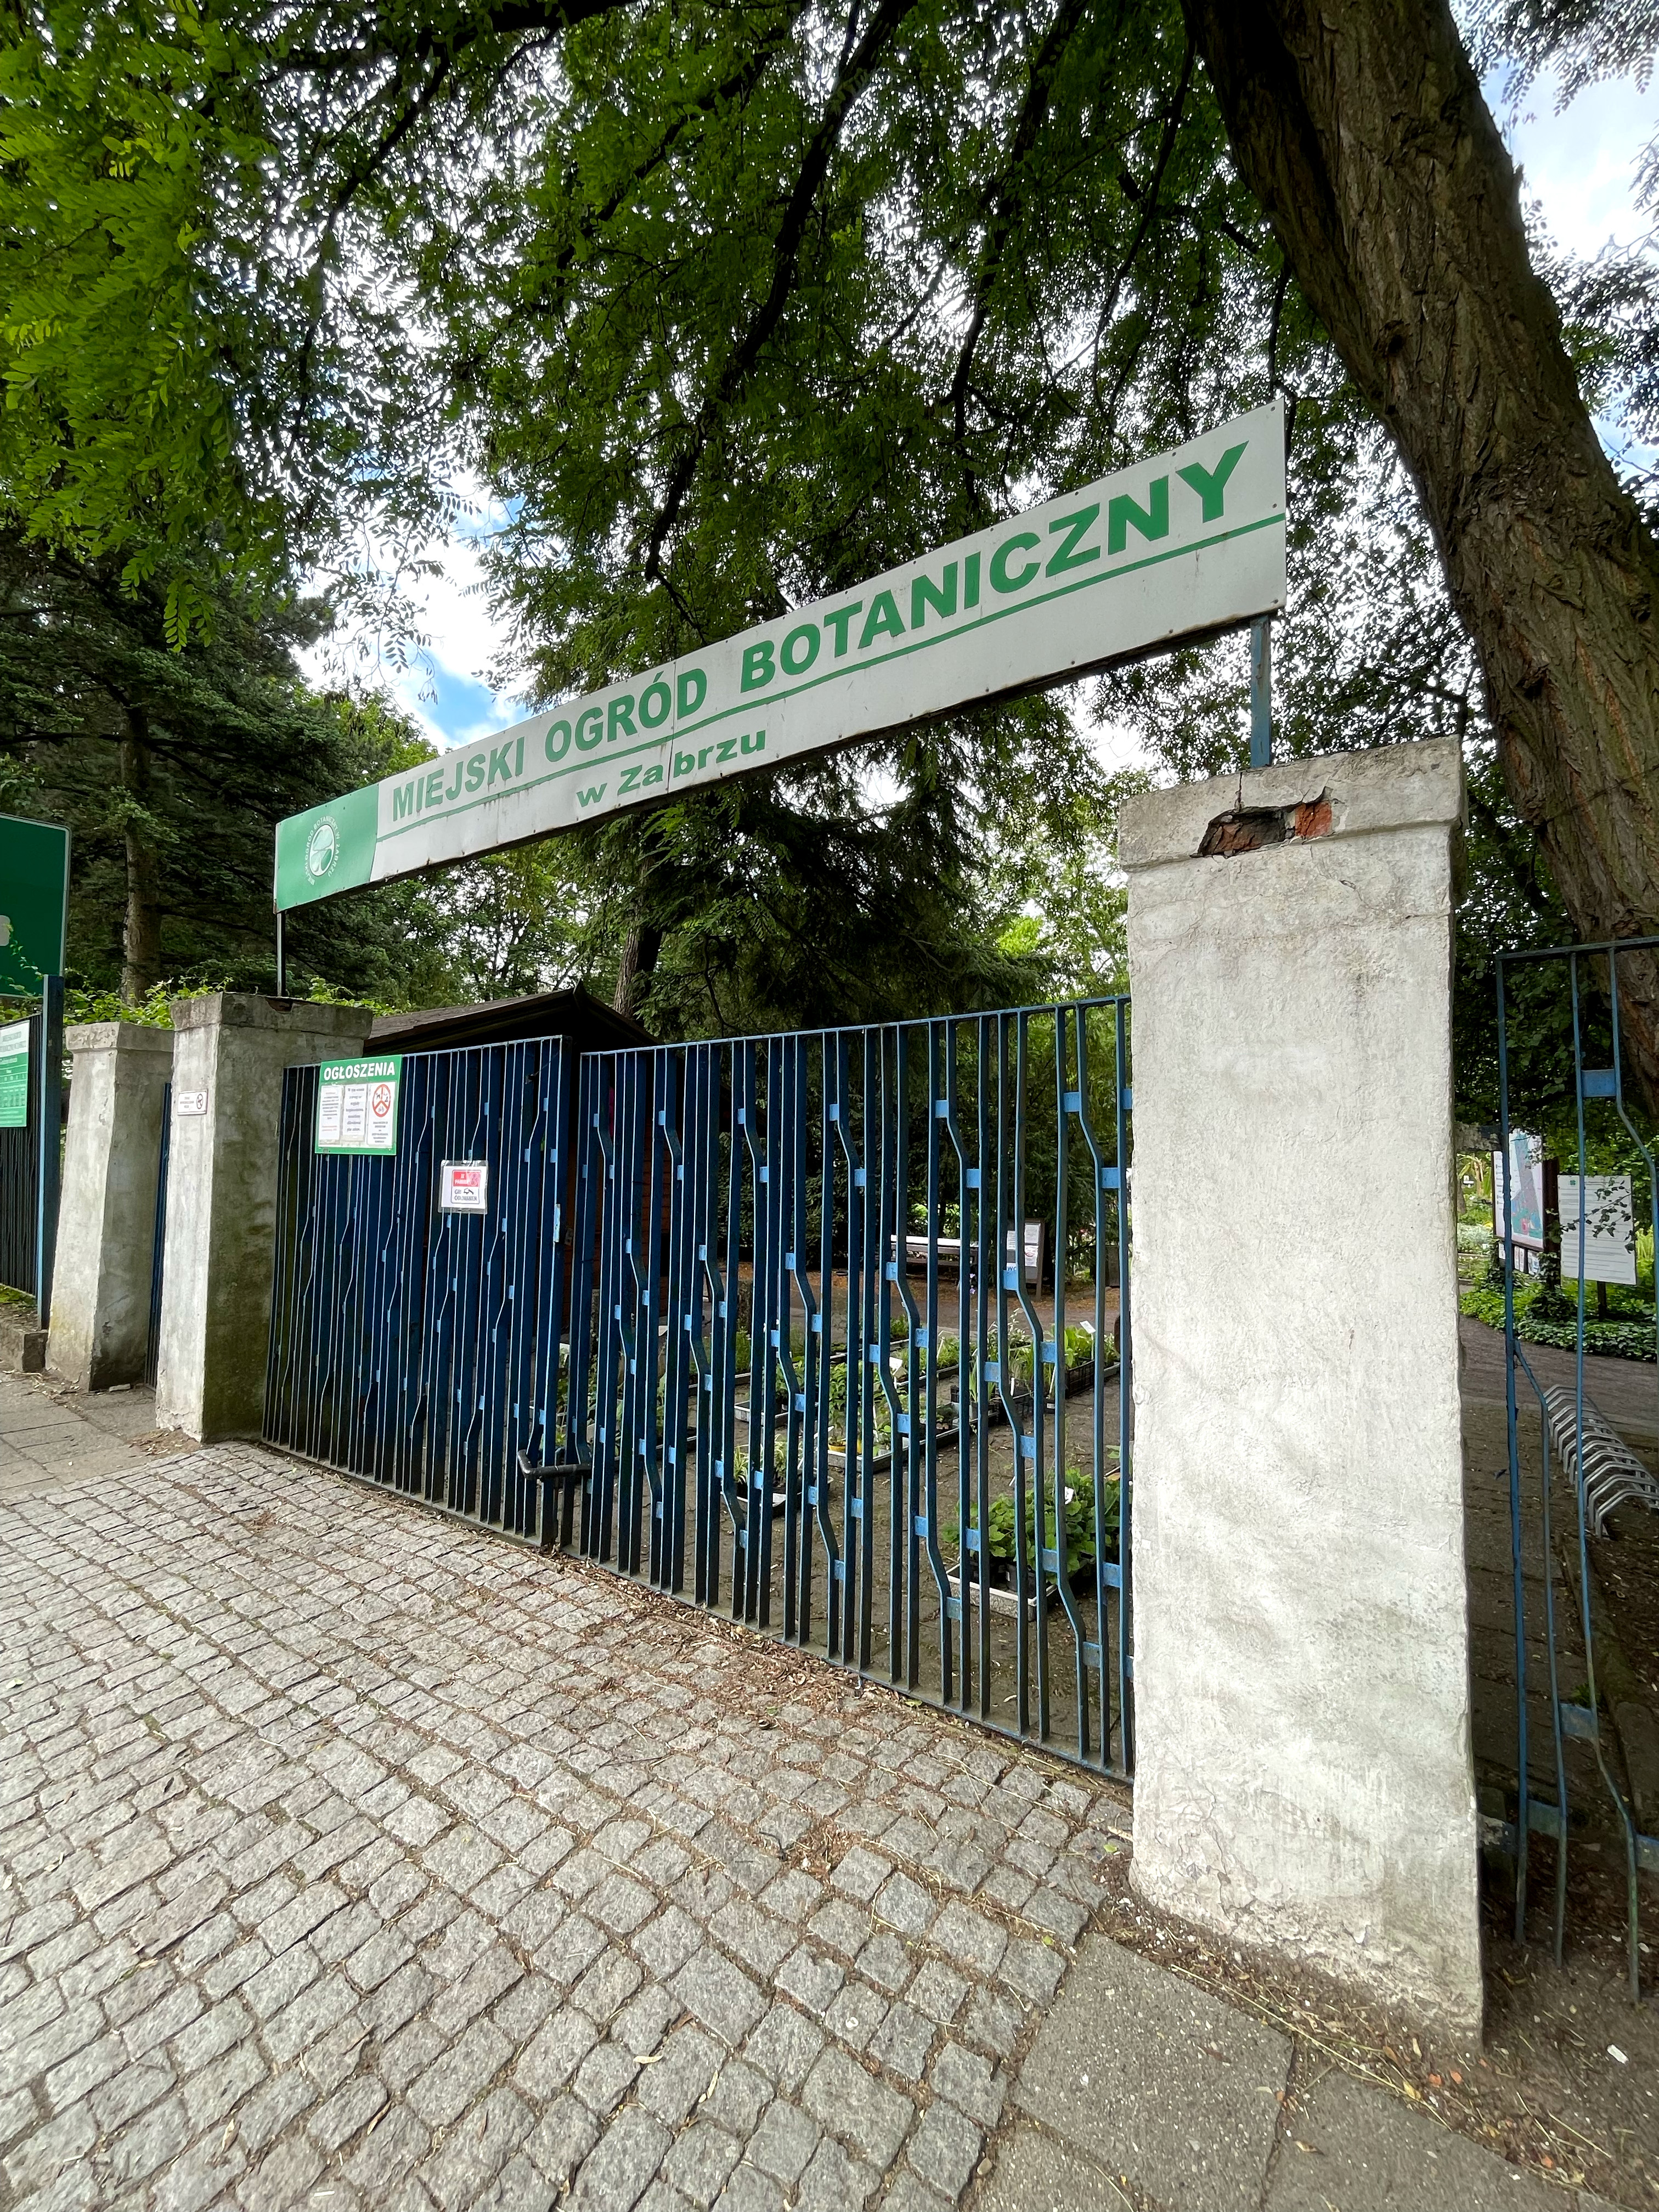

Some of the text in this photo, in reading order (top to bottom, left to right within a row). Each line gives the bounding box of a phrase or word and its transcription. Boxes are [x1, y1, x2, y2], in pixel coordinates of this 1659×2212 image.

[393, 441, 1248, 821] MIEJSKI OGRÓD BOTANICZNY
[577, 783, 607, 808] w
[324, 1062, 395, 1080] OGŁOSZENIA
